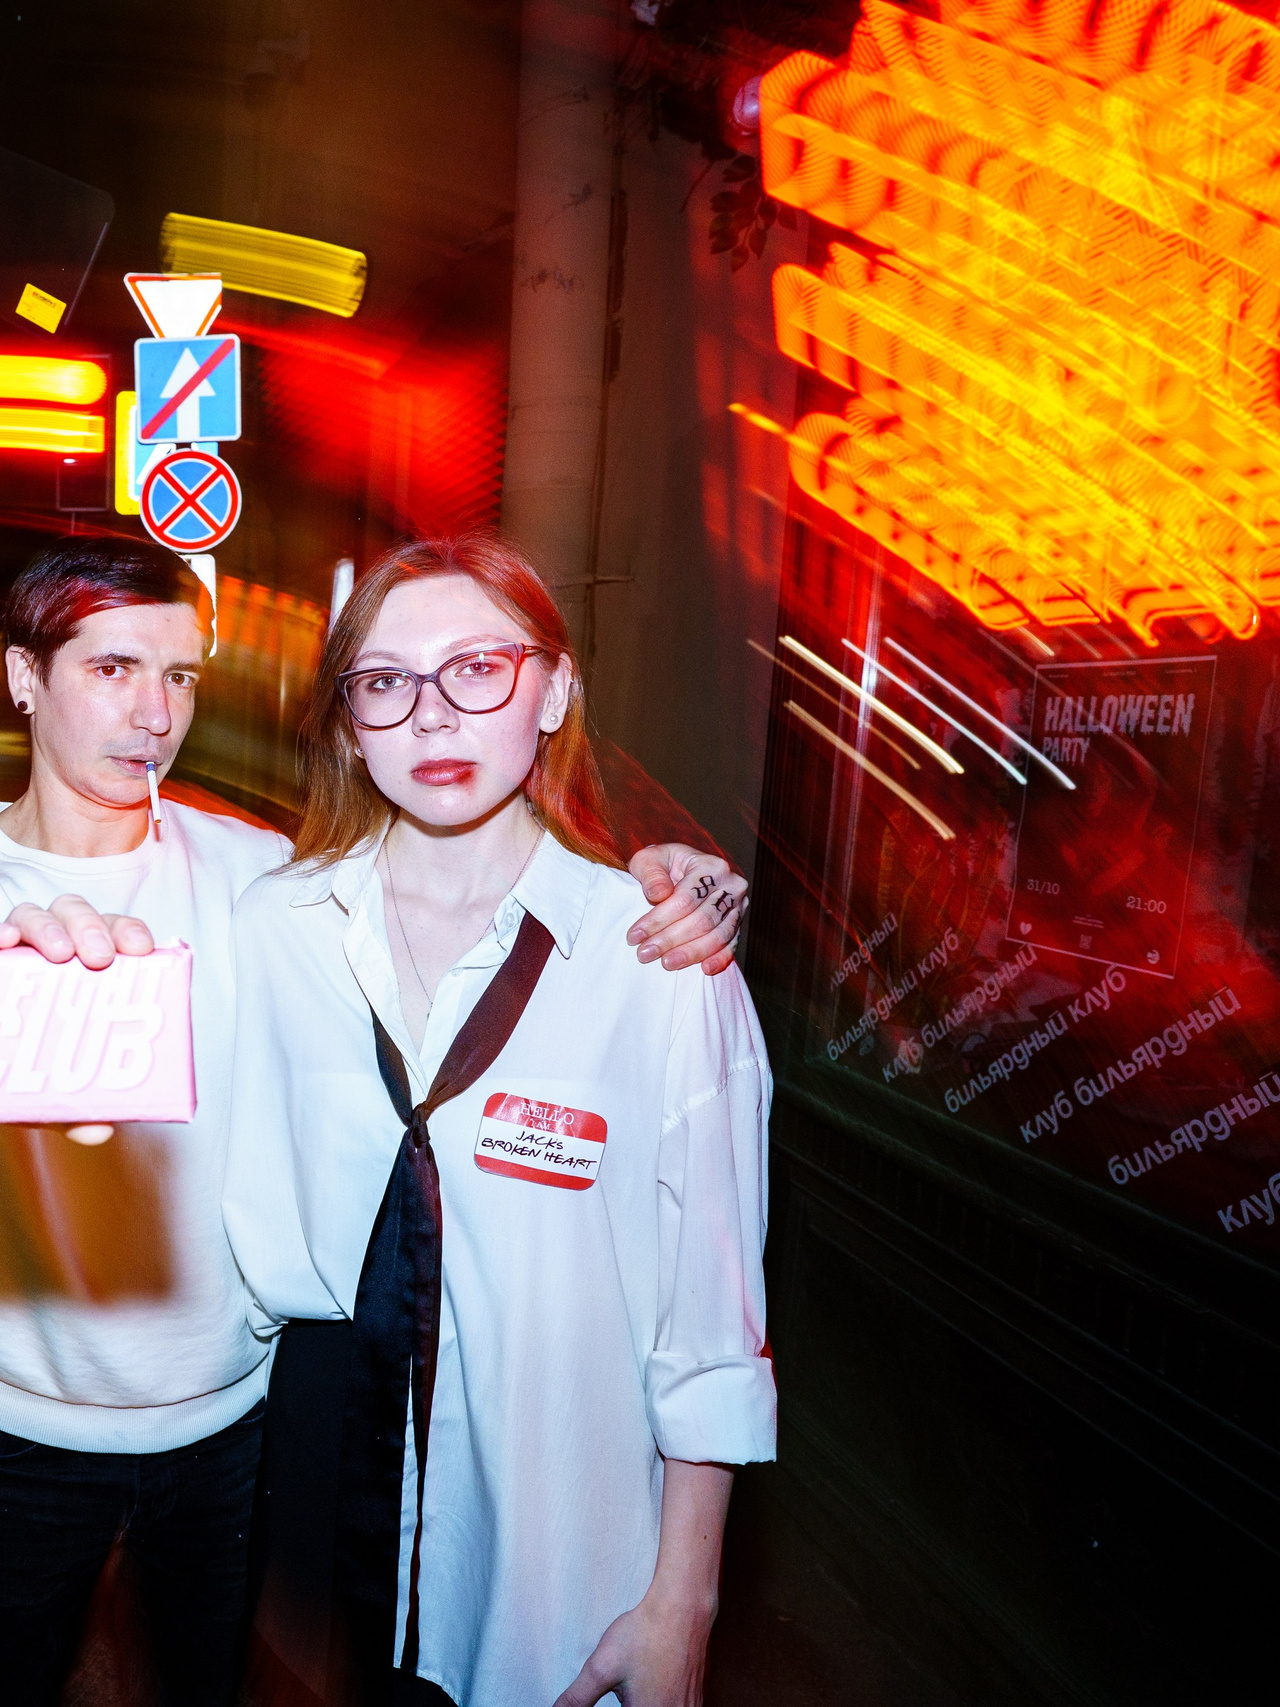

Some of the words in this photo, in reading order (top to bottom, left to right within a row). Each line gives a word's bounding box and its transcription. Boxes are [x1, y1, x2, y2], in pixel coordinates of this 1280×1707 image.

[1044, 693, 1195, 738] HALLOWEEN
[1042, 737, 1090, 766] PARTY
[1027, 879, 1060, 895] 31/10
[1126, 896, 1167, 914] 21:00
[826, 969, 919, 1061] бильярдный
[917, 926, 960, 979] клуб
[881, 1036, 922, 1083] клуб
[921, 943, 1038, 1048] бильярдный
[944, 1010, 1069, 1114] бильярдный
[1067, 963, 1127, 1024] клуб
[1020, 1090, 1074, 1144] клуб
[1074, 986, 1242, 1107] бильярдный
[520, 1103, 574, 1125] HELLO
[481, 1138, 541, 1158] BROKEN
[544, 1152, 597, 1170] HEART
